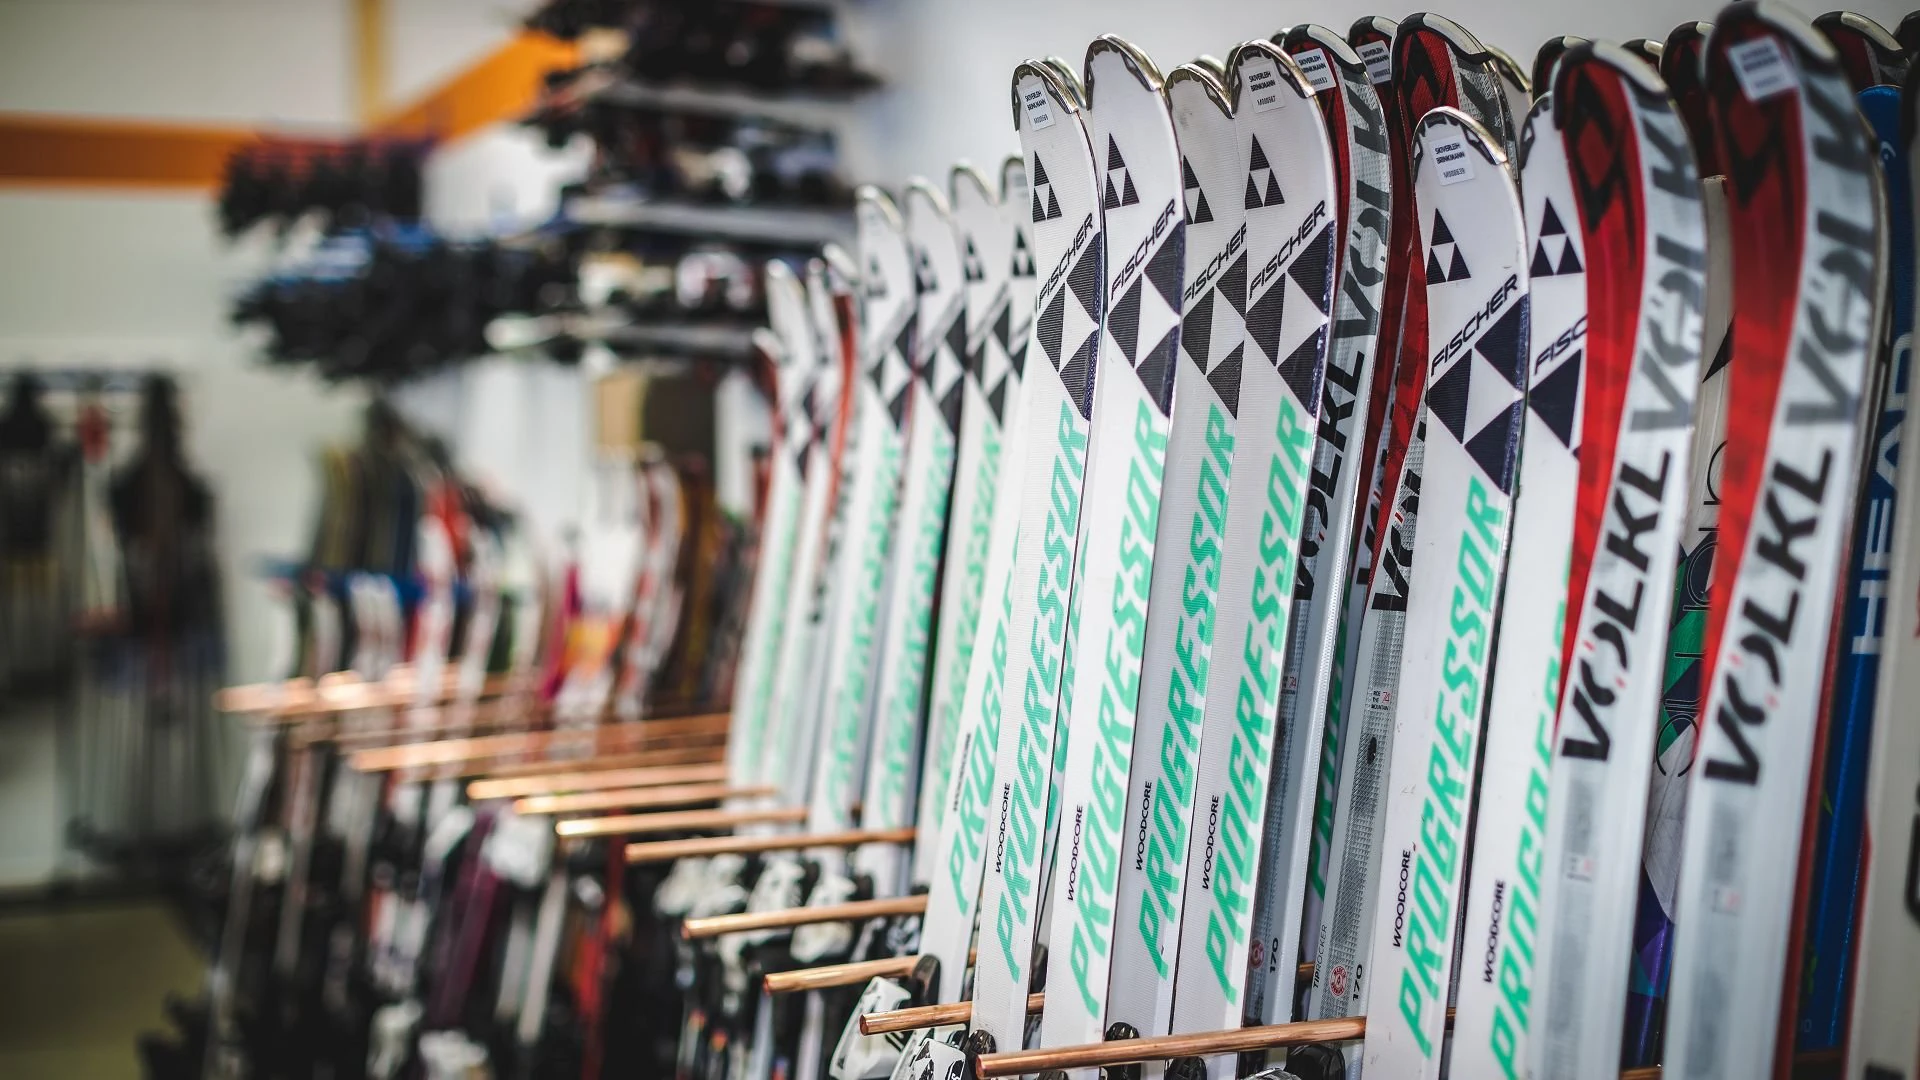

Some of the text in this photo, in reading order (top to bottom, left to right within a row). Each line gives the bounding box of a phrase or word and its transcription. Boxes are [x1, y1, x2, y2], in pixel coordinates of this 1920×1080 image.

[1039, 212, 1093, 309] FISCHER
[1110, 198, 1176, 301] FISCHER
[1249, 200, 1326, 300] FISCHER
[1431, 273, 1518, 377] FISCHER
[1534, 313, 1588, 376] FISC
[1561, 449, 1672, 762] VÖLKL
[1703, 444, 1834, 787] VÖLKL
[996, 400, 1087, 984] PROGRESSOR
[1069, 397, 1168, 1020] PROGRESSOR
[1138, 402, 1236, 981] PROGRESSOR
[1205, 395, 1316, 1006] PROGRESSOR
[1399, 475, 1505, 1061] PROGRESSOR
[995, 782, 1011, 874] WOODCORE
[1067, 804, 1084, 902] WOODCORE
[1135, 780, 1153, 871] WOODCORE
[1202, 794, 1220, 890] WOODCORE
[1393, 849, 1411, 948] WOODCORE
[1483, 878, 1507, 984] WOODCORE
[1269, 937, 1279, 974] 170
[1352, 963, 1363, 1001] 170
